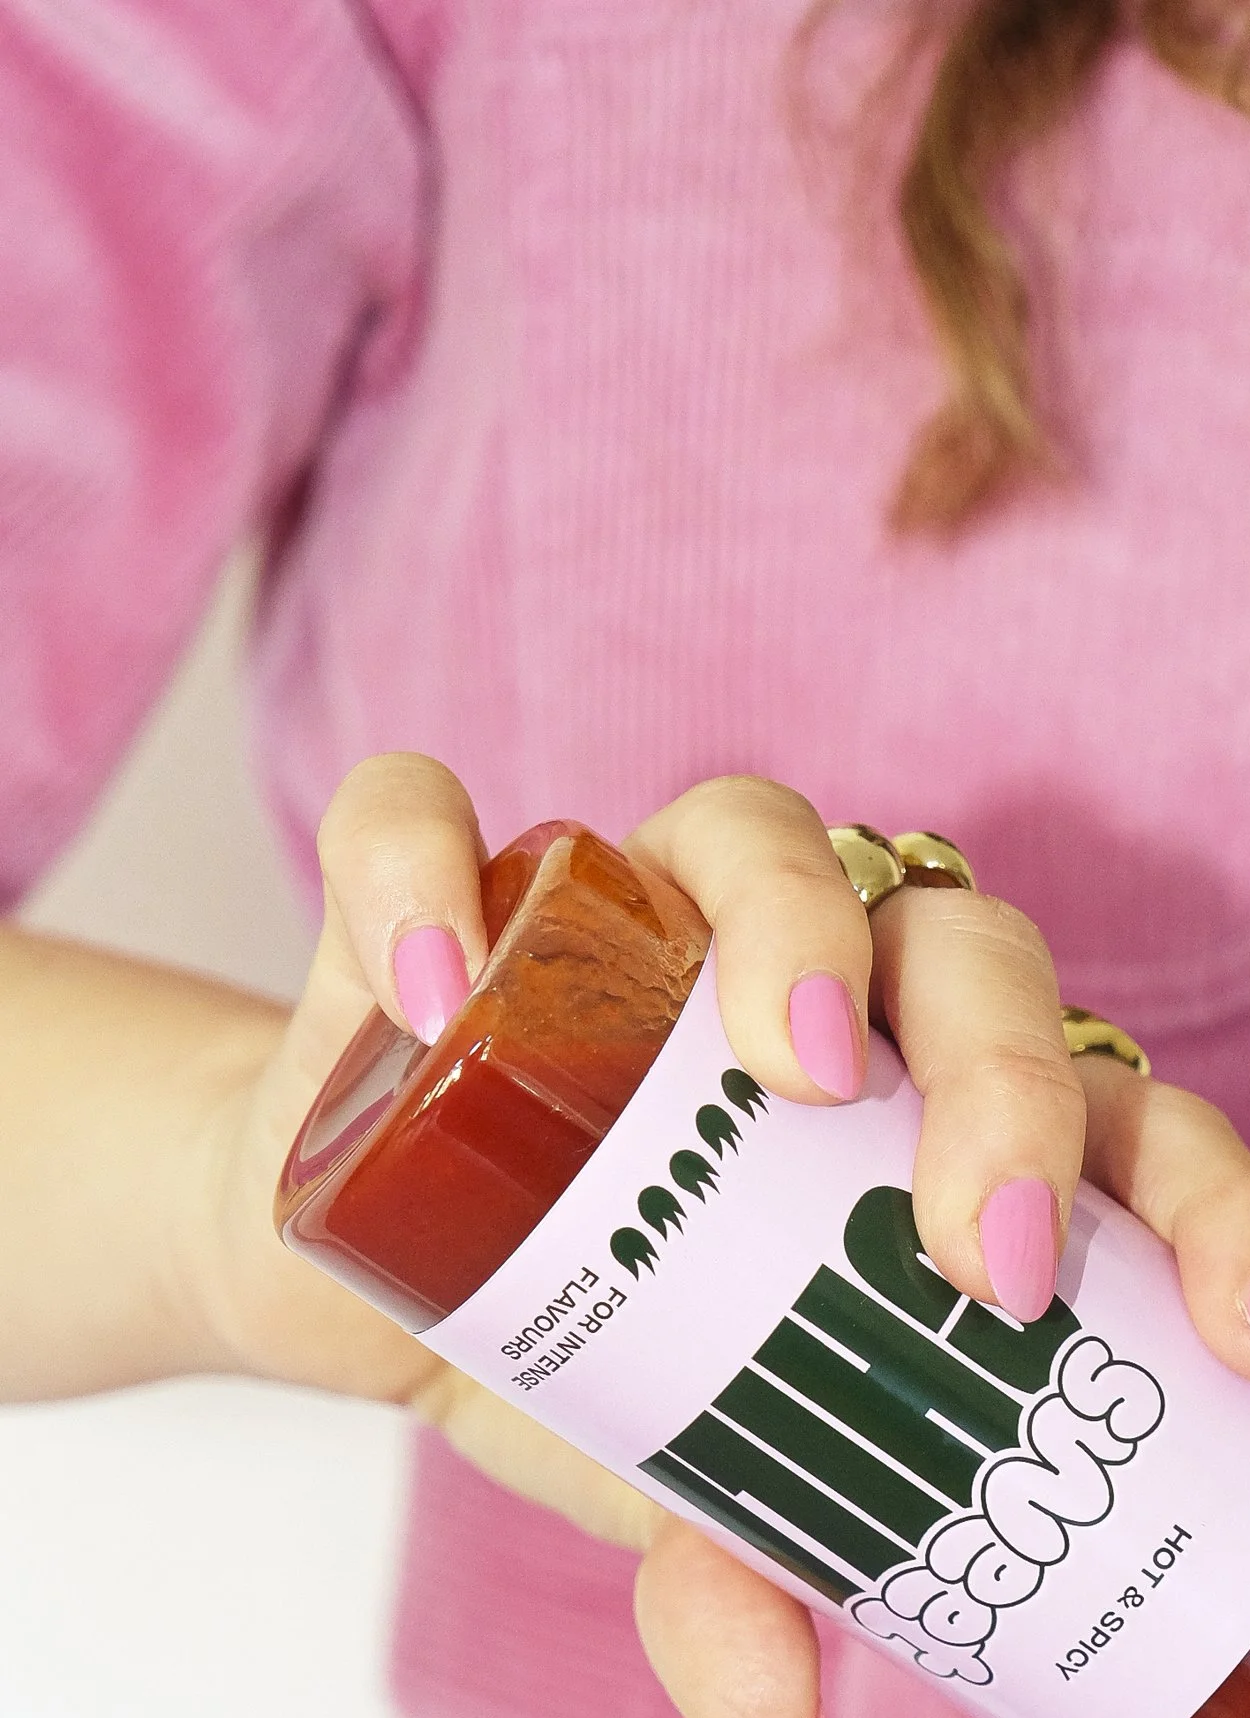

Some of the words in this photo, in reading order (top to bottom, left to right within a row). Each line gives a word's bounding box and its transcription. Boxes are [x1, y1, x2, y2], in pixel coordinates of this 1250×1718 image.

[500, 1266, 600, 1360] FLAVOURS
[577, 1286, 628, 1334] FOR
[511, 1331, 587, 1391] INTENSE
[1141, 1524, 1193, 1589] HOT
[1117, 1586, 1145, 1609] &
[1055, 1611, 1125, 1681] SPICY
